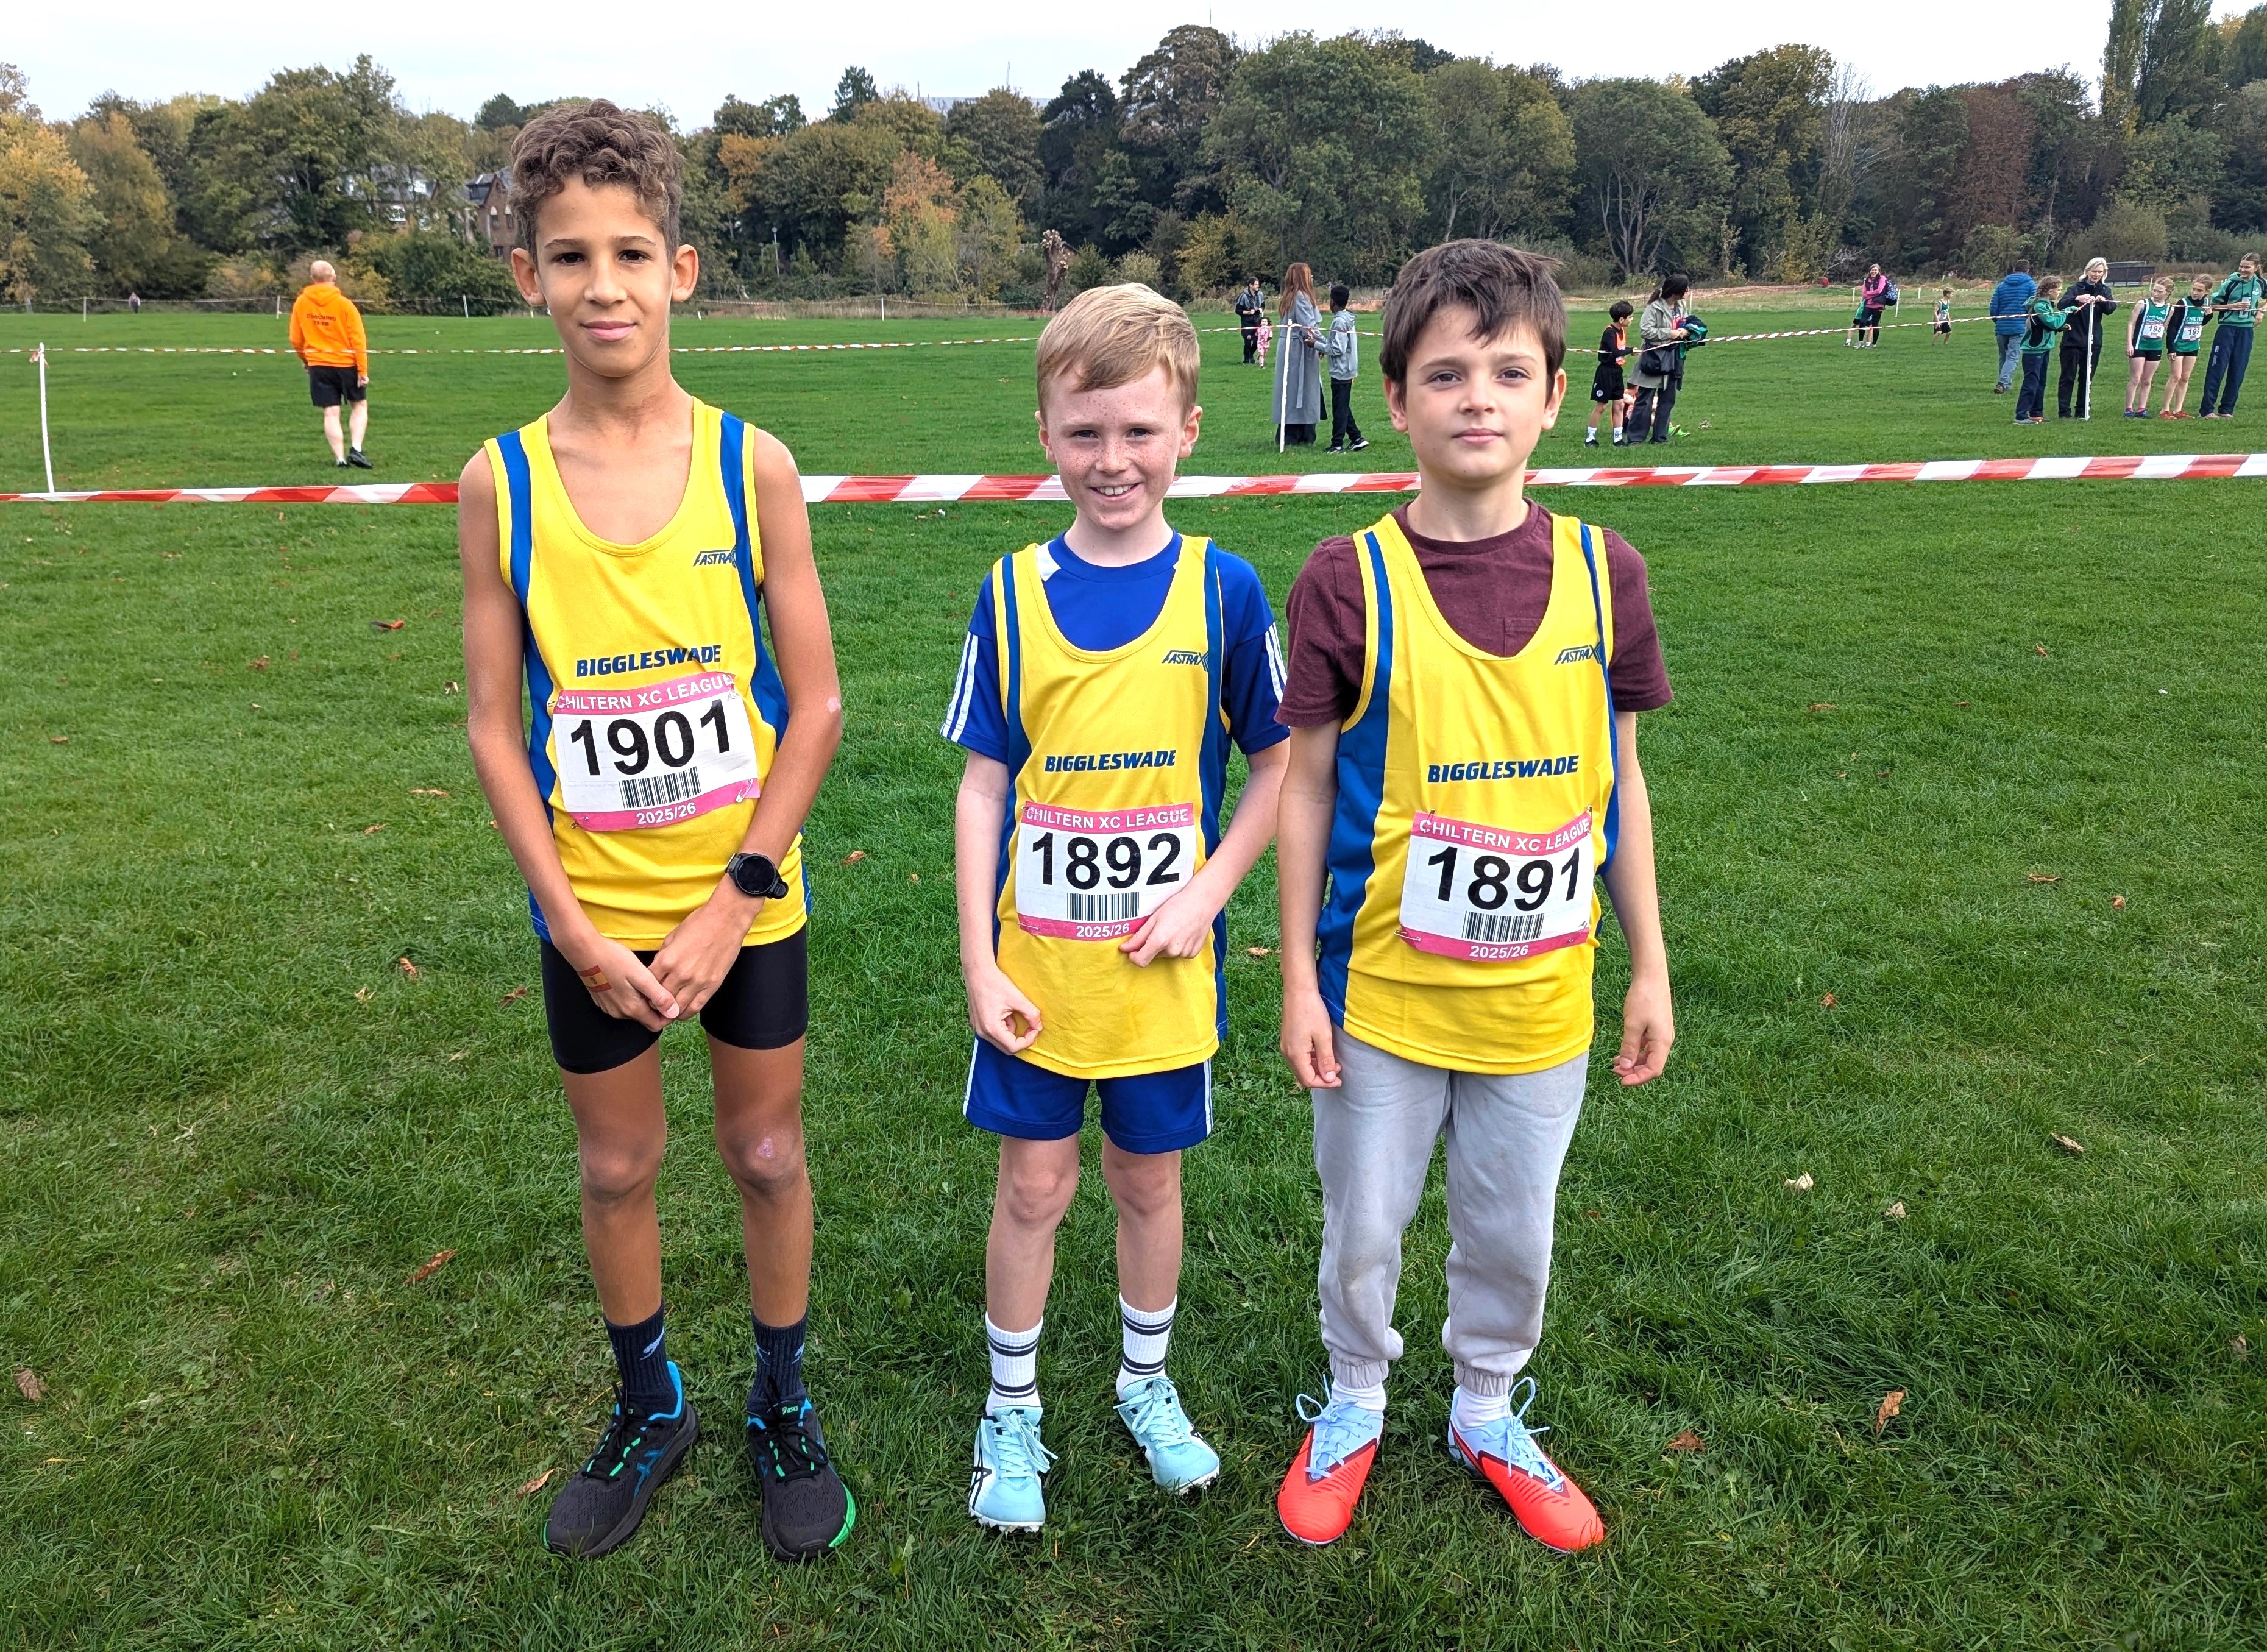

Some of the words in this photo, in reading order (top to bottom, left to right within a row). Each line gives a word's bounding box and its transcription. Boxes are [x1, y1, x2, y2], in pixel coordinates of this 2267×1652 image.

[577, 645, 722, 677] BIGGLESWADE
[558, 695, 632, 709] CHILTERN
[639, 690, 662, 707] XC
[667, 674, 734, 700] LEAGUE
[570, 699, 731, 776] 1901
[1045, 750, 1176, 772] BIGGLESWADE
[1428, 755, 1579, 783] BIGGLESWADE
[636, 803, 697, 825] 2025/26
[1026, 806, 1093, 829] CHILTERN
[1099, 817, 1121, 829] XC
[1126, 808, 1188, 826] LEAGUE
[1419, 819, 1510, 849] CHILTERN
[1515, 837, 1541, 851] XC
[1545, 818, 1590, 851] LEAGUE
[1032, 832, 1182, 890] 1892
[1427, 846, 1580, 911] 1891
[1076, 923, 1130, 939] 2025/26
[1469, 945, 1529, 959] 2025/26
